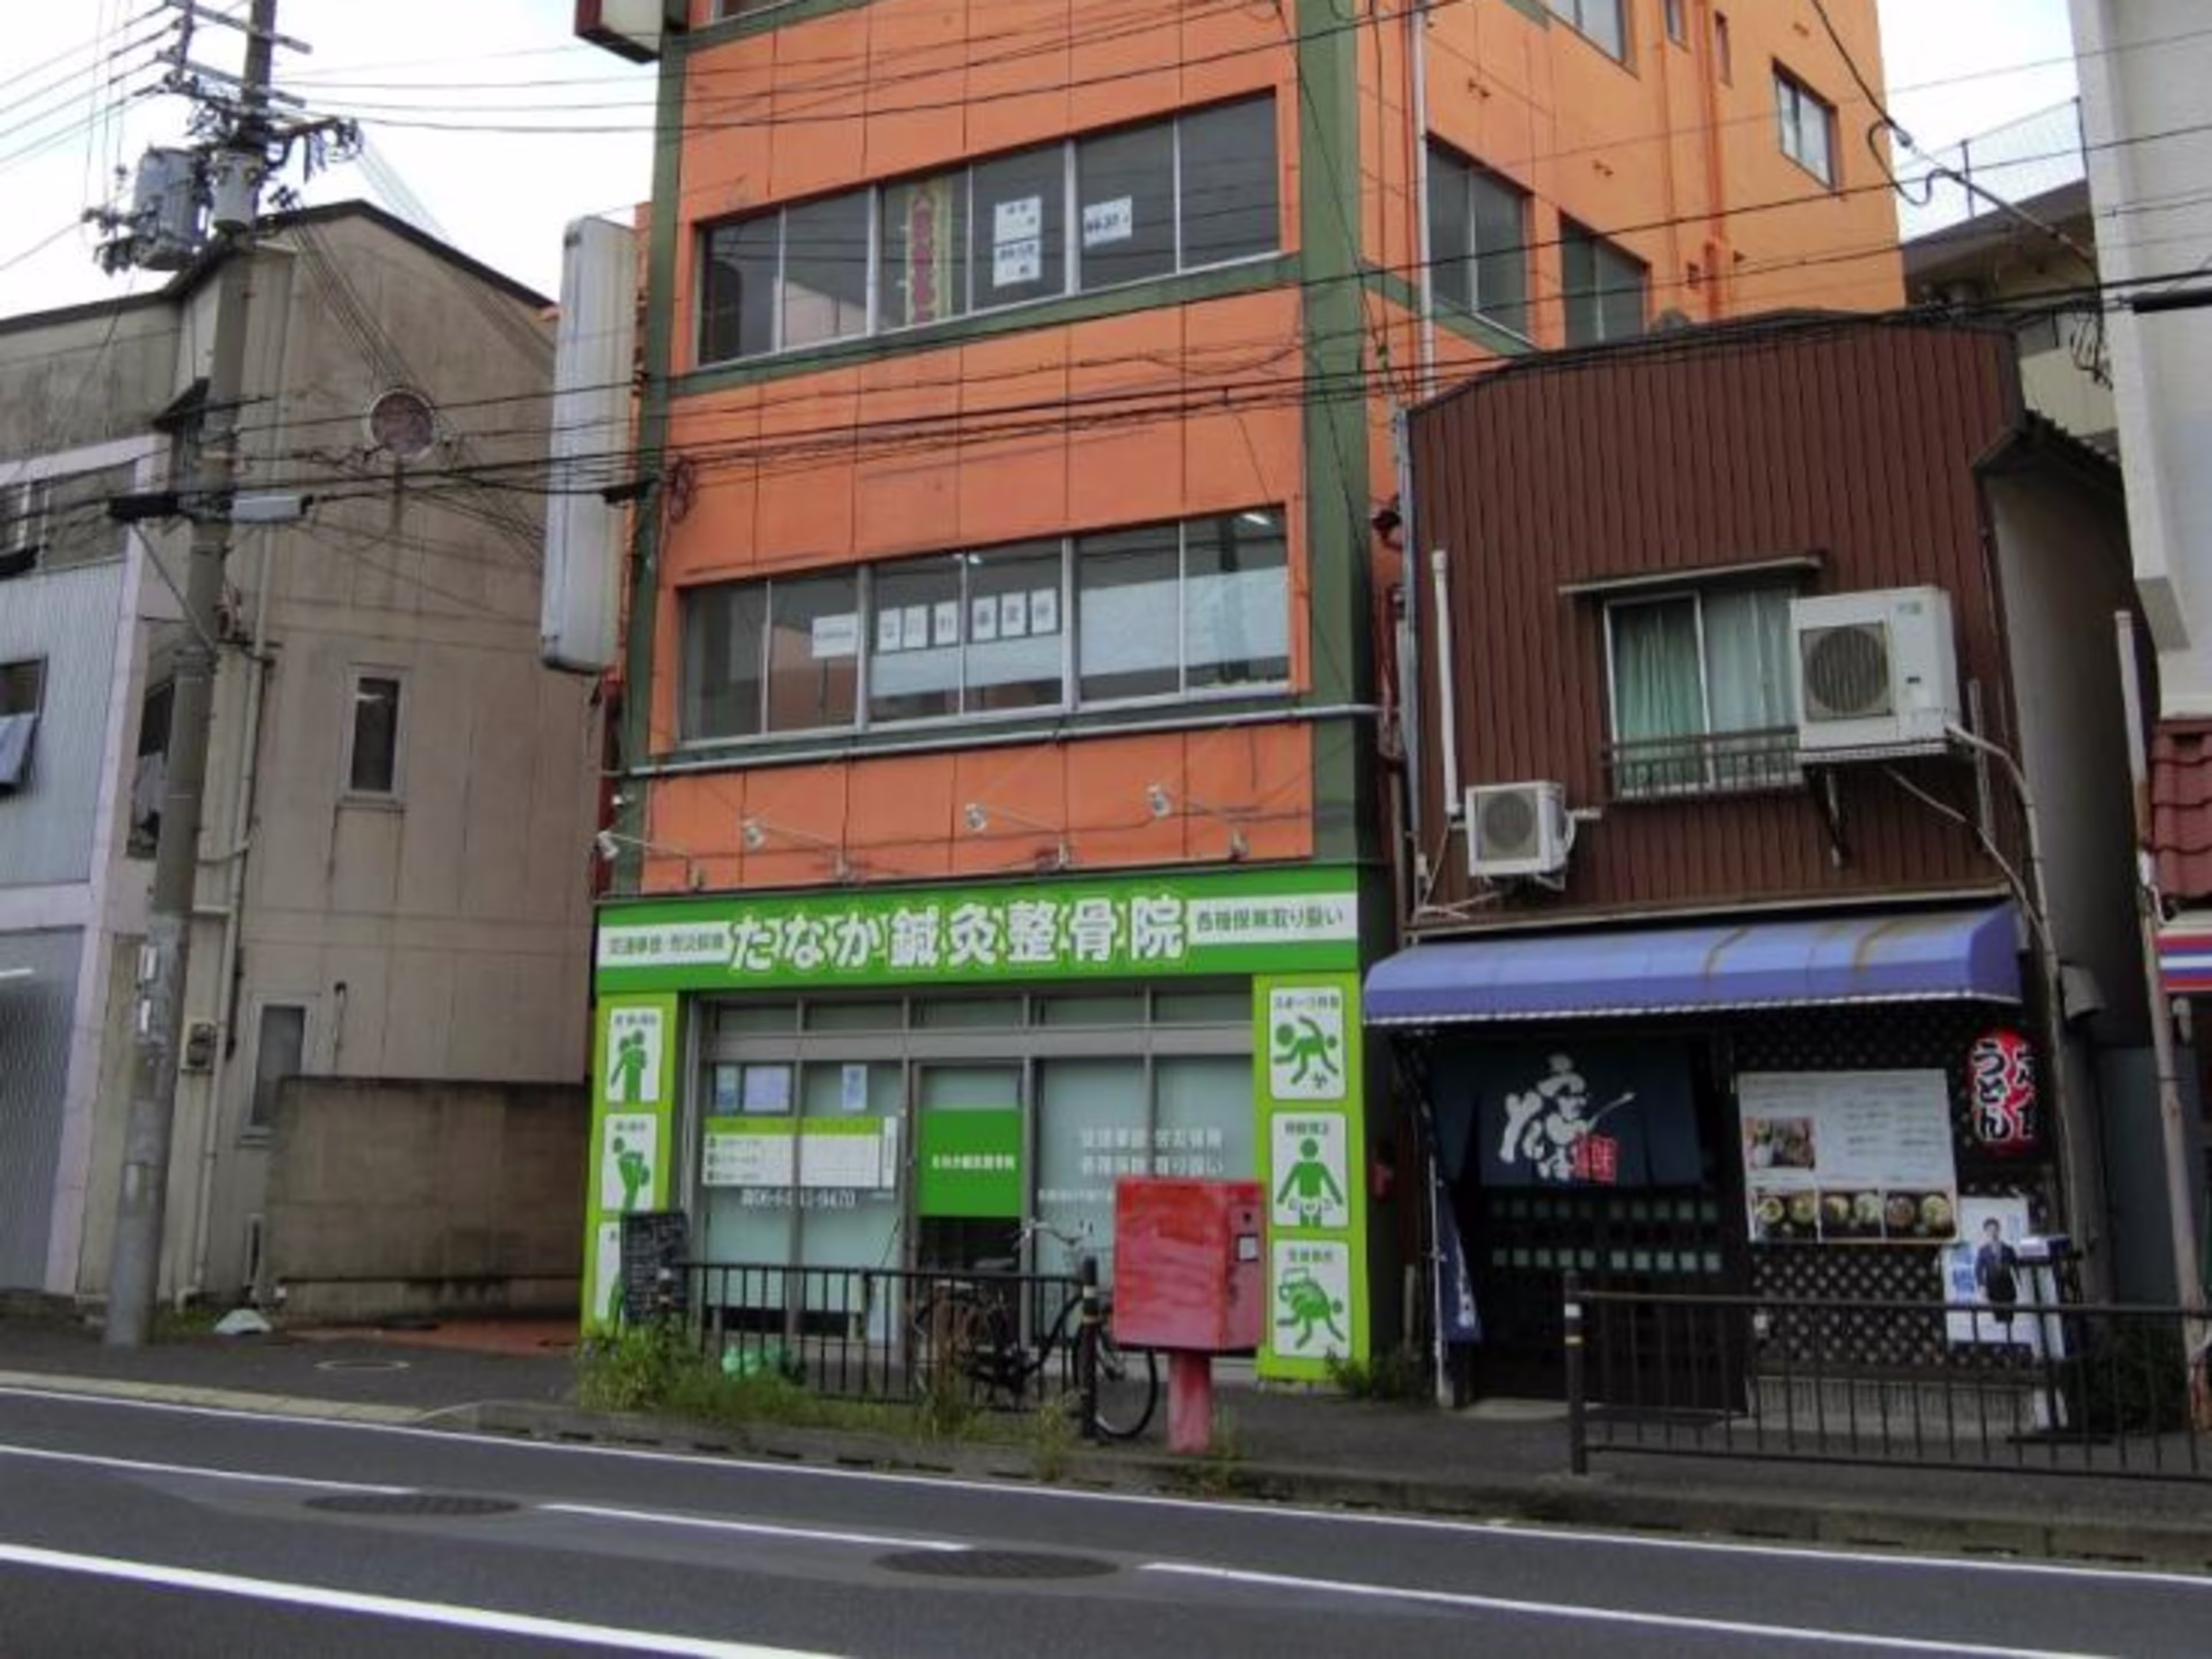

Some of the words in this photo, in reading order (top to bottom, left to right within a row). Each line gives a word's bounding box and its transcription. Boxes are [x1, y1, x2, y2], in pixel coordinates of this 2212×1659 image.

[730, 895, 1183, 970] たなか鍼灸整骨院
[1974, 1038, 2013, 1142] うどん
